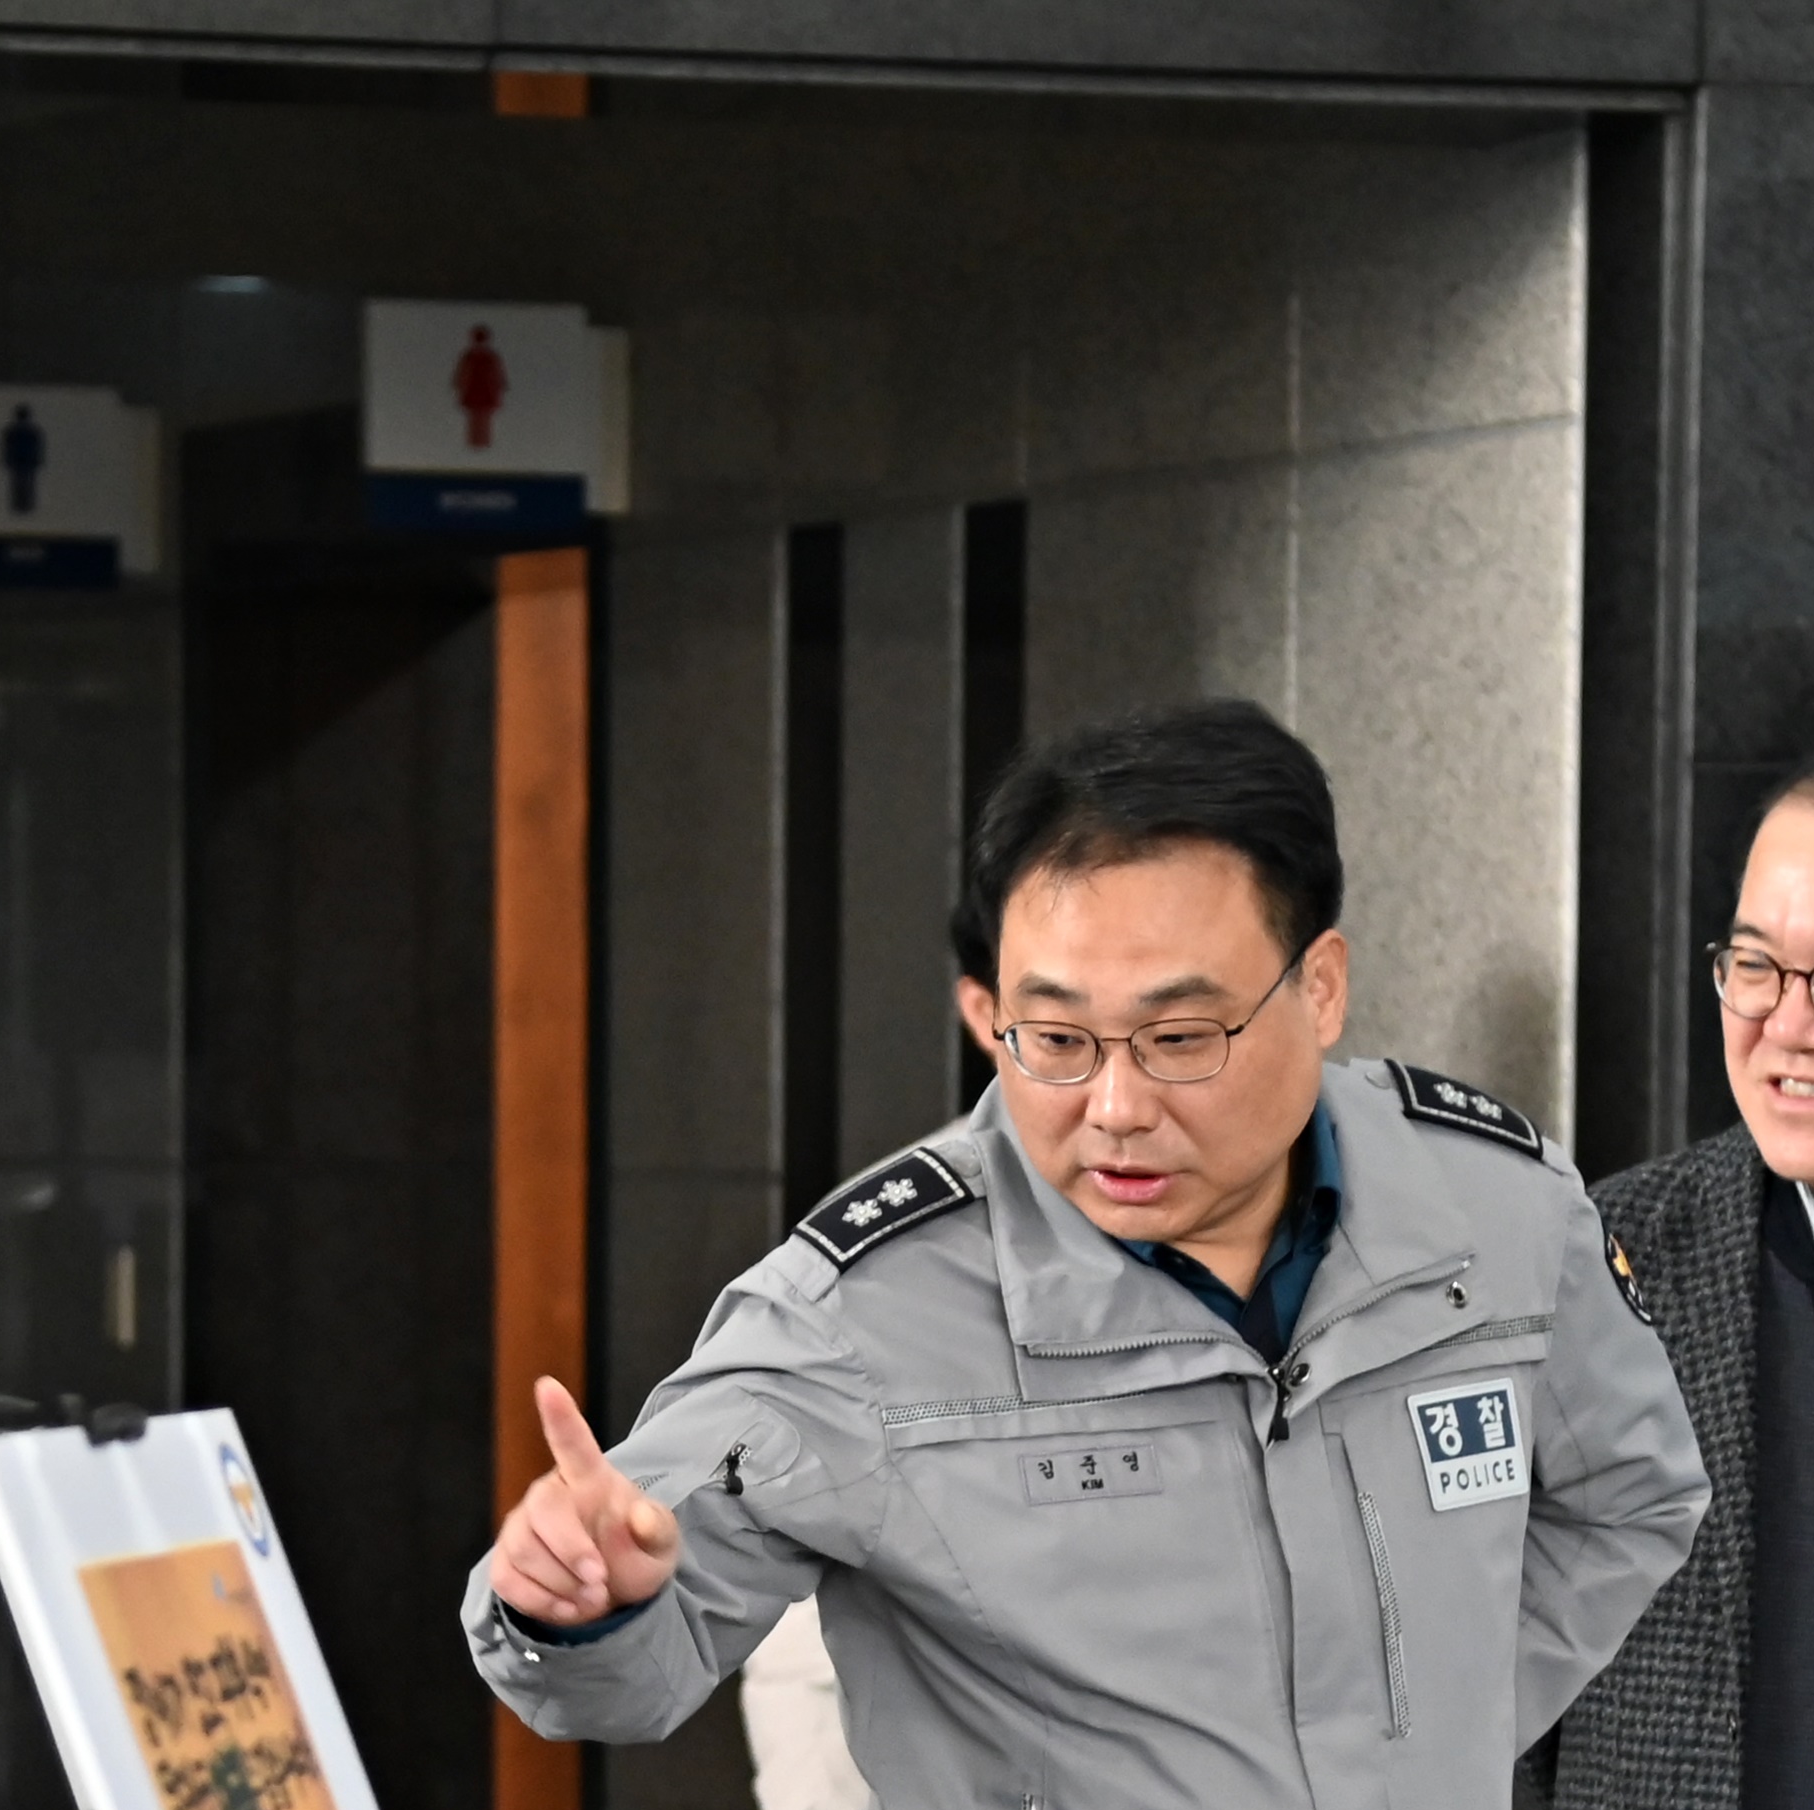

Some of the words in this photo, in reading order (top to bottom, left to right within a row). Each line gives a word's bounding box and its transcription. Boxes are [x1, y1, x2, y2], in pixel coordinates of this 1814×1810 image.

[1425, 1395, 1505, 1457] 경찰
[1080, 1478, 1104, 1491] KIM
[1439, 1458, 1516, 1494] POLICE
